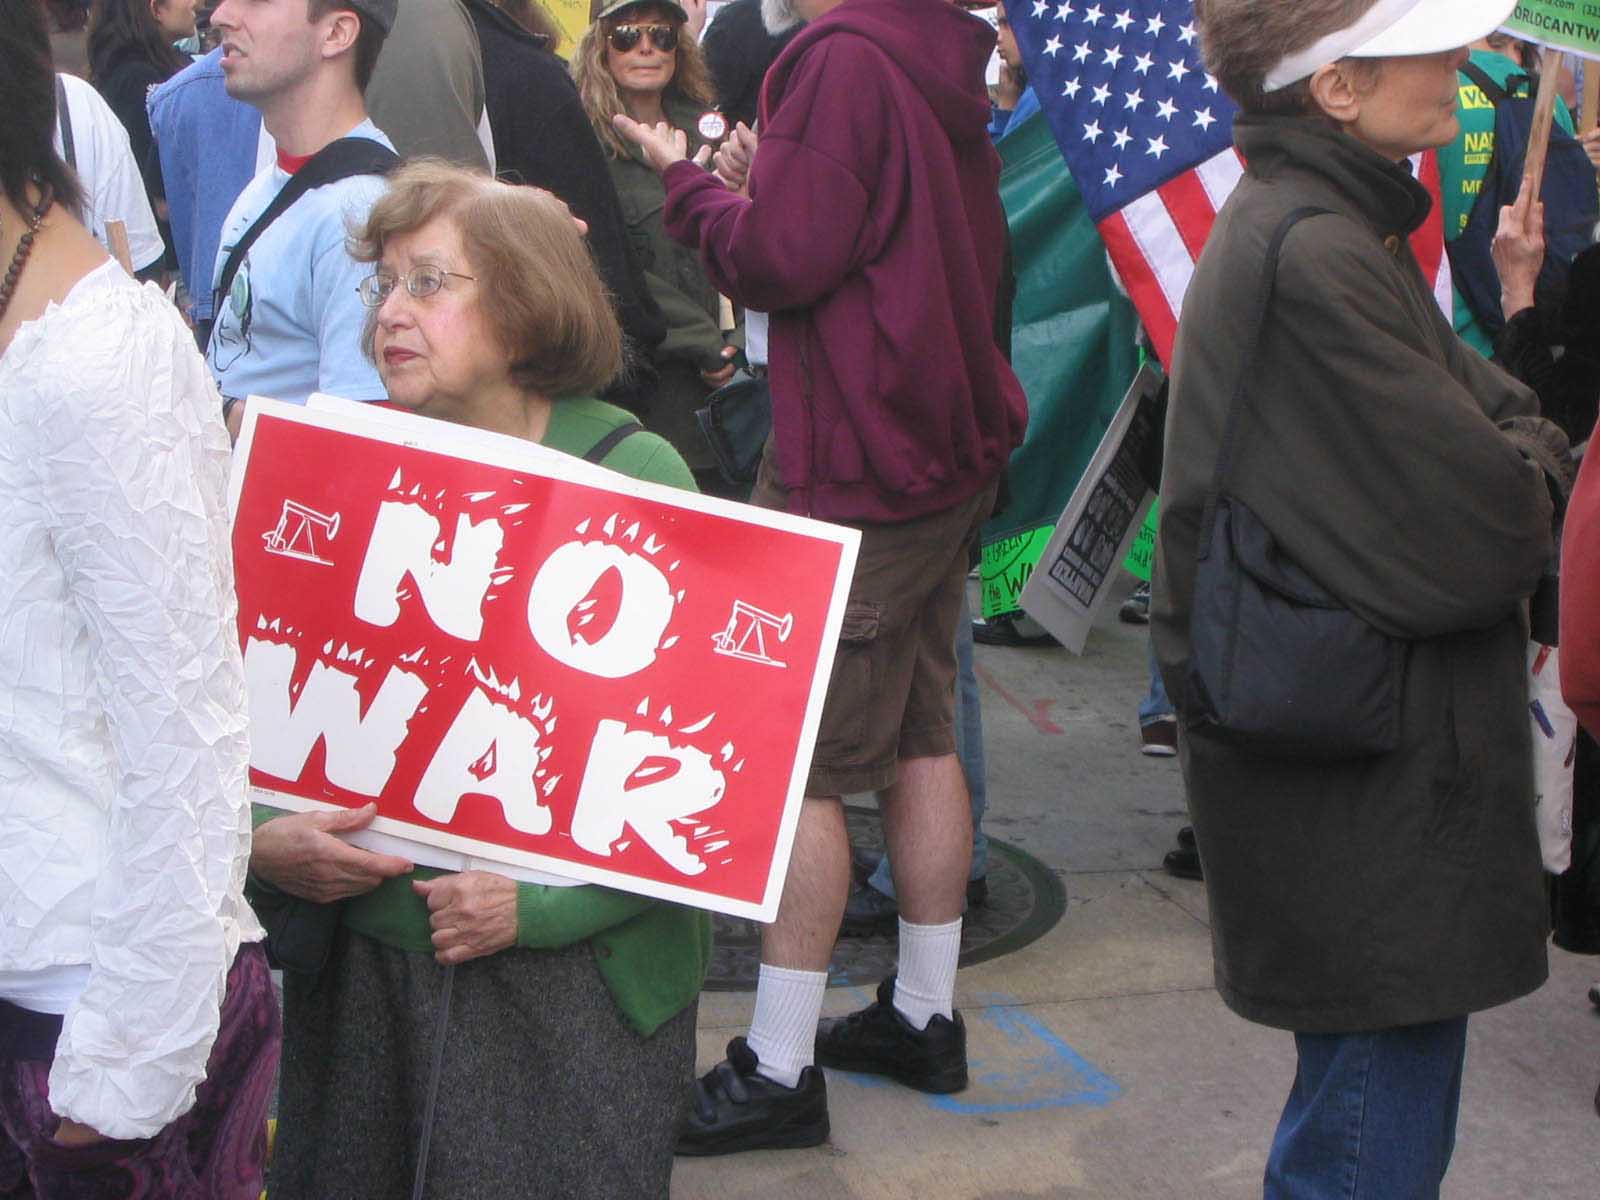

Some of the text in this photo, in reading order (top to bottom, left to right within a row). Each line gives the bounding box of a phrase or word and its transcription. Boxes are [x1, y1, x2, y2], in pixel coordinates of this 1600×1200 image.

[1510, 6, 1600, 44] ORLDCANTW
[352, 497, 681, 679] NO
[244, 634, 727, 878] WAR
